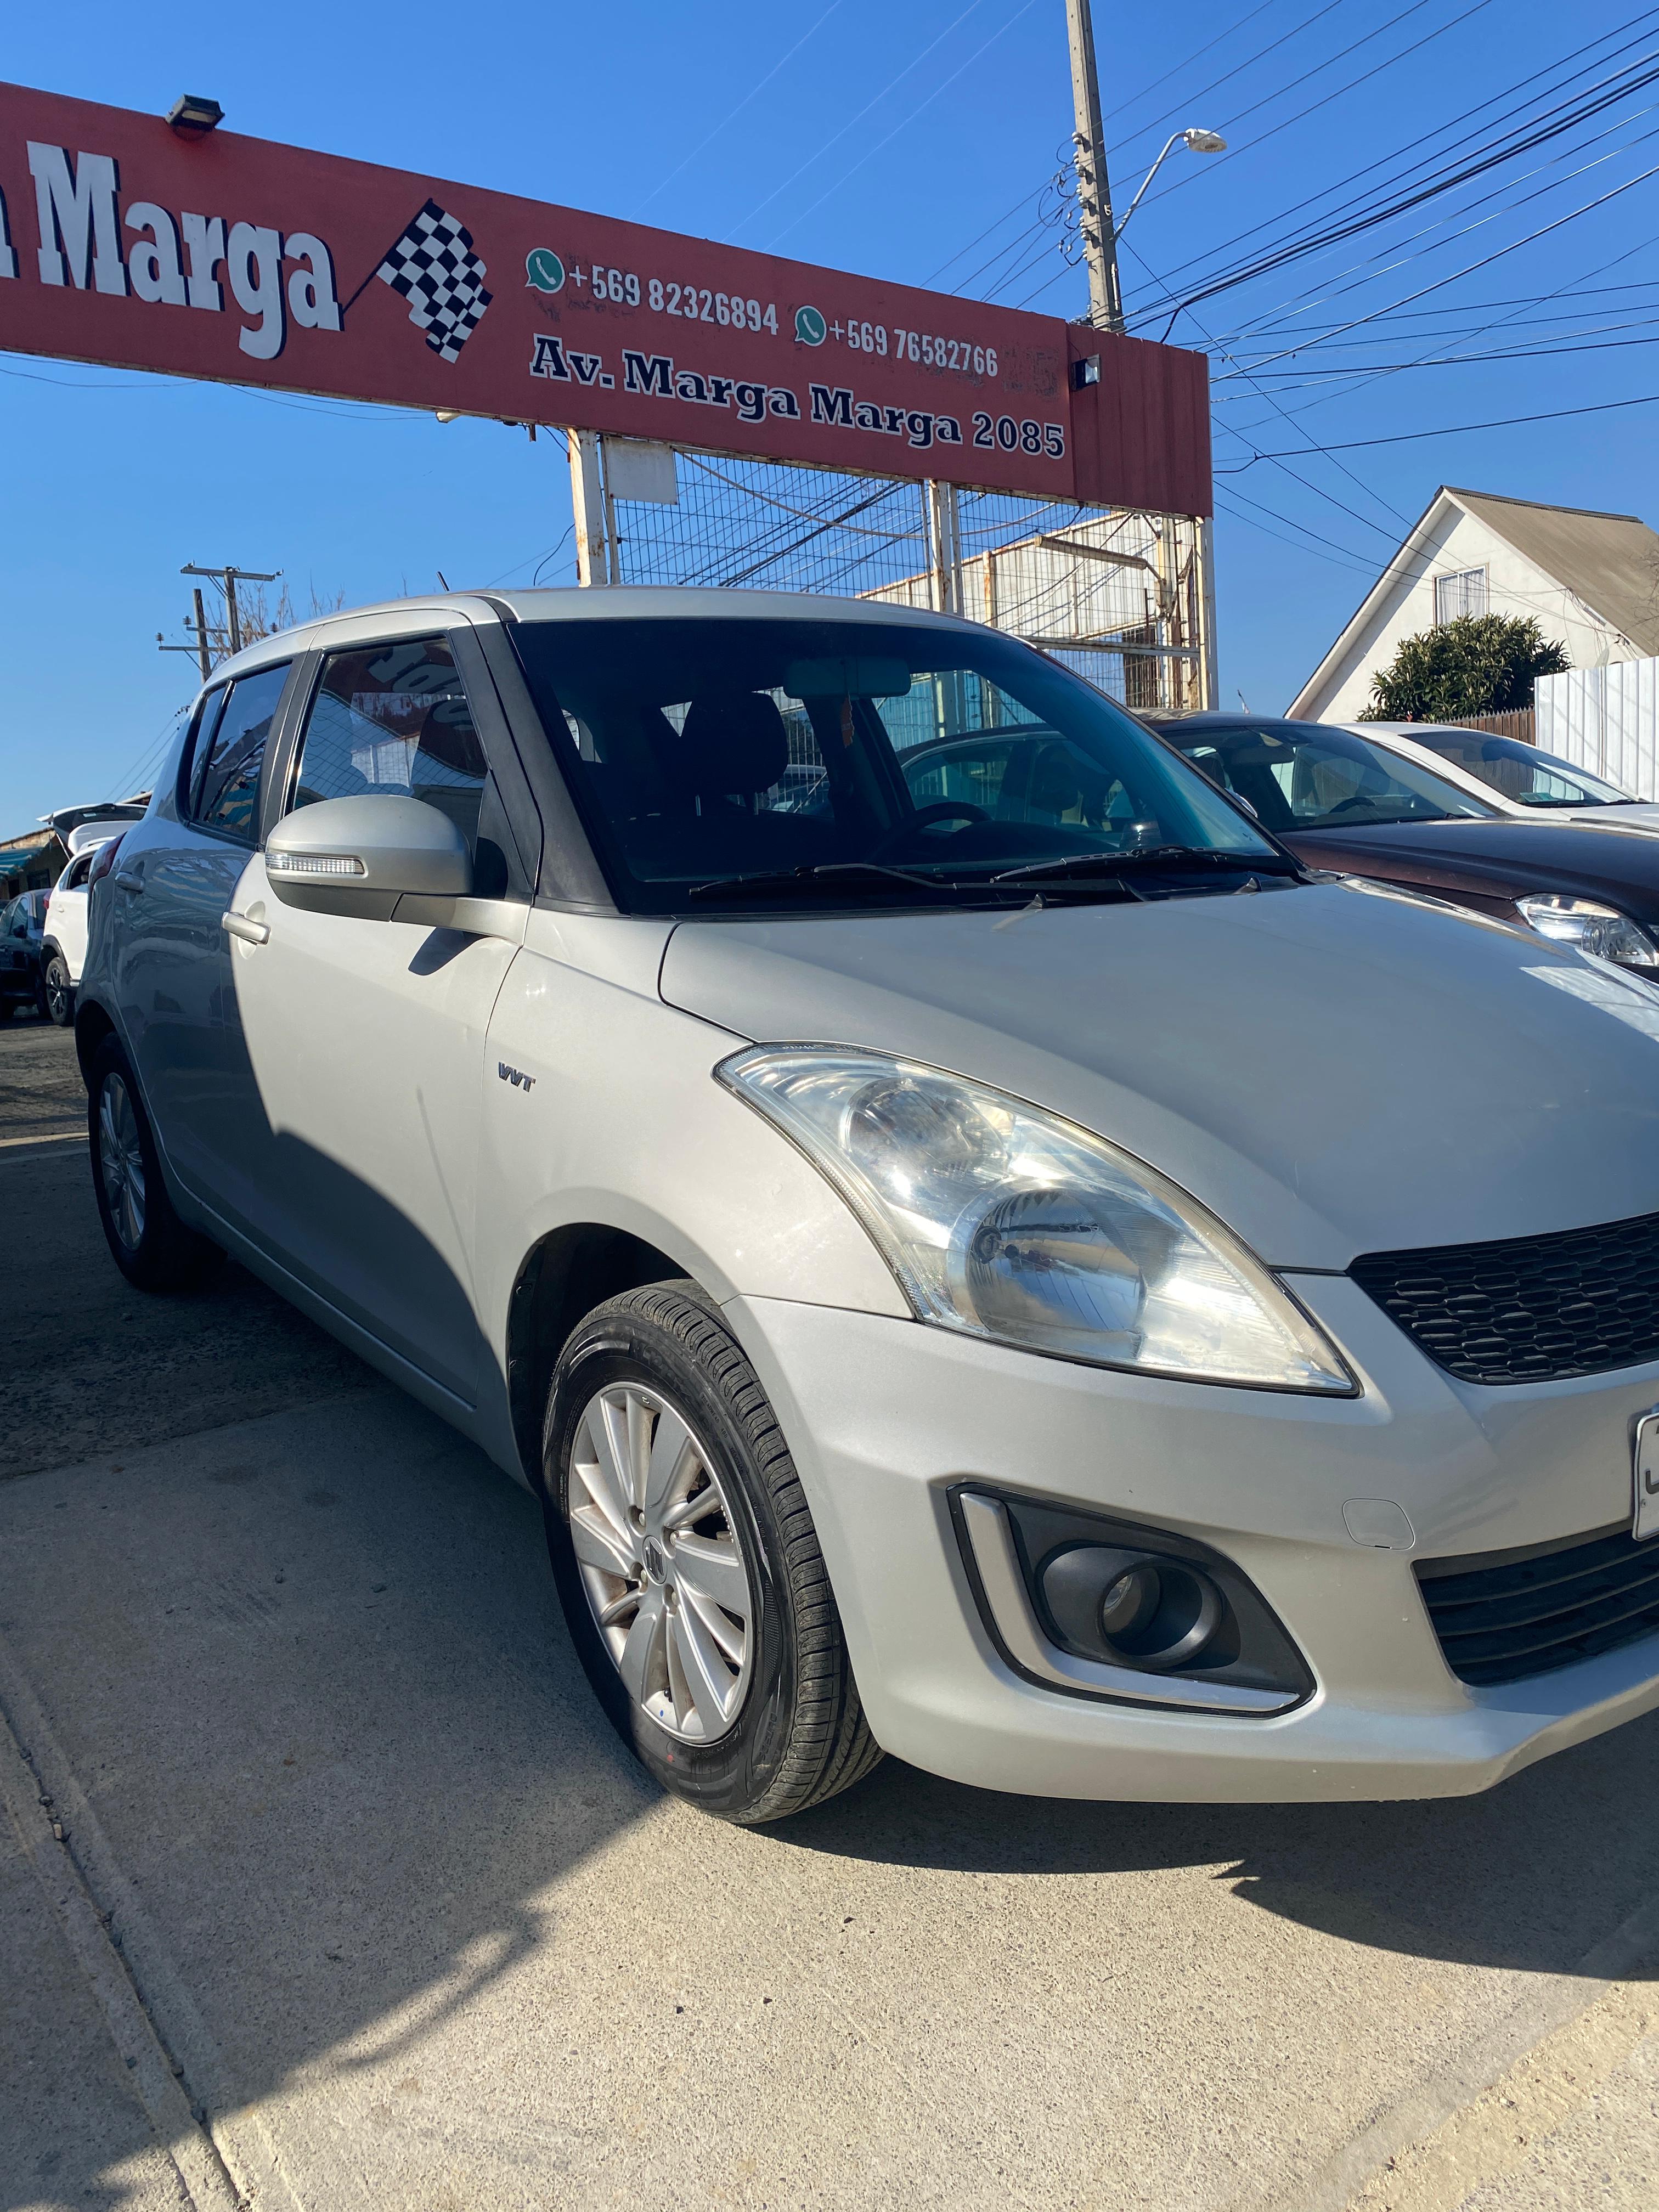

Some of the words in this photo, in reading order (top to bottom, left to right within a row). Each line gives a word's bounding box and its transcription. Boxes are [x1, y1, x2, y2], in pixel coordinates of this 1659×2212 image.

[26, 140, 345, 360] Marga
[569, 264, 641, 307] +569
[648, 278, 779, 335] 82326894
[829, 319, 888, 356] +569
[894, 328, 998, 377] 76582766
[529, 332, 615, 390] Av.
[622, 348, 801, 424] Marga
[808, 382, 963, 450] Marga
[972, 411, 1065, 460] 2085
[498, 1062, 537, 1093] VVT
